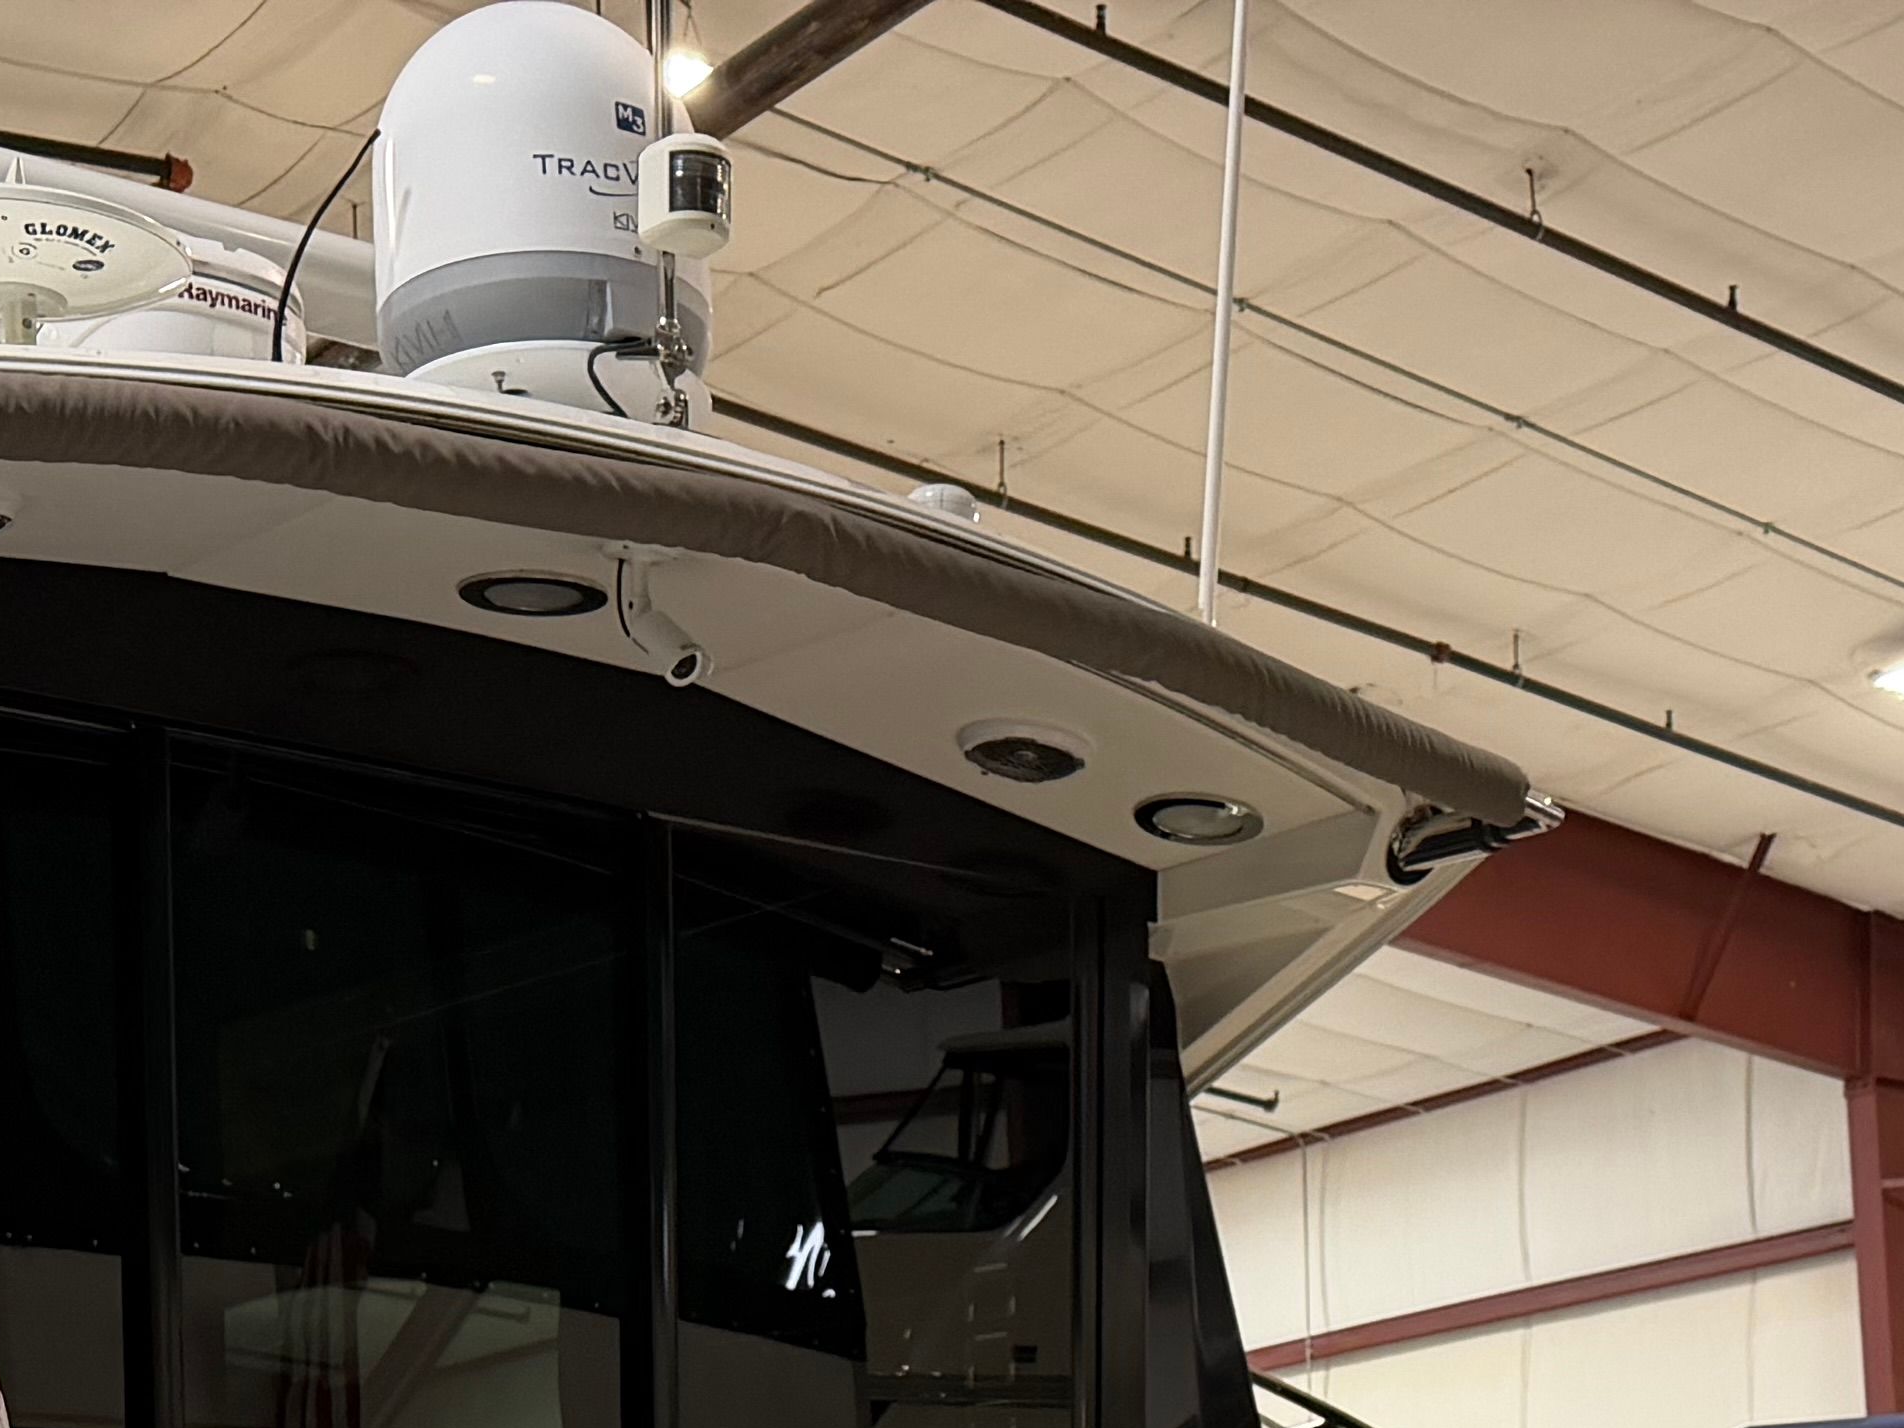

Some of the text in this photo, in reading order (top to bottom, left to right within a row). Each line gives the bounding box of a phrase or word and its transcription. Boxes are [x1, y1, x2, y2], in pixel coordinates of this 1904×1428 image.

[617, 104, 644, 133] M3
[533, 153, 639, 185] TRACV
[24, 223, 115, 253] GLOMEX
